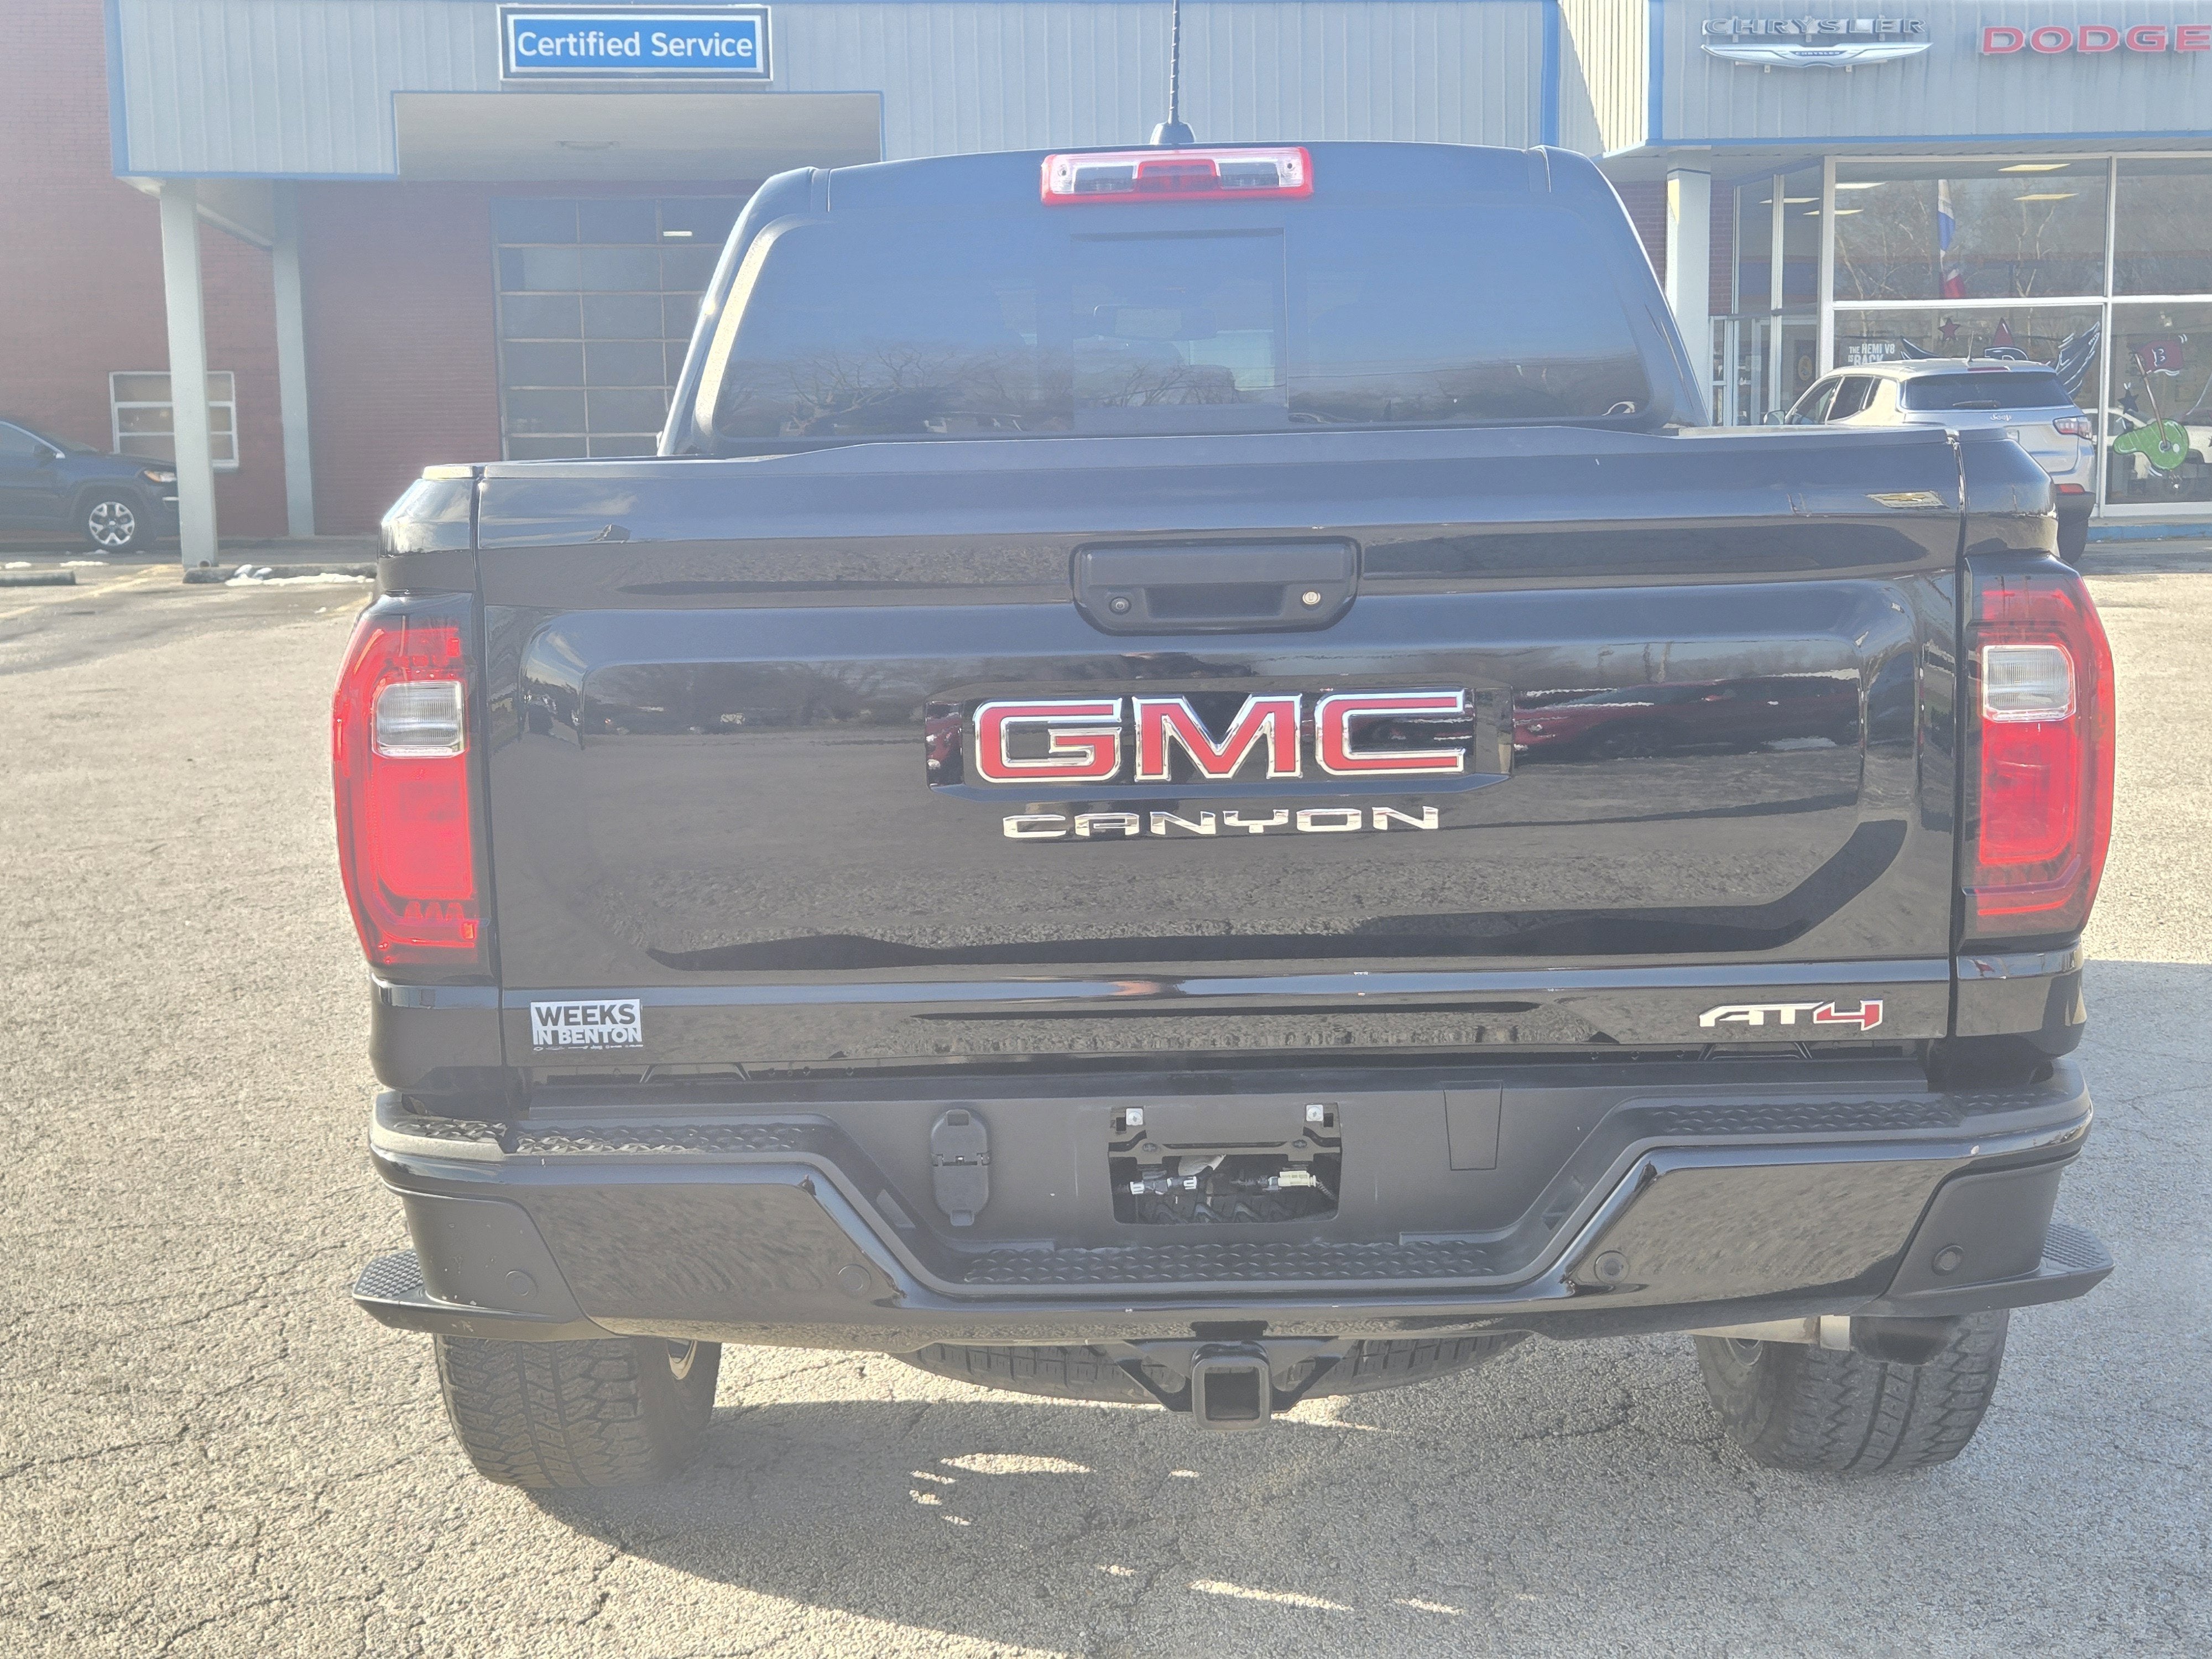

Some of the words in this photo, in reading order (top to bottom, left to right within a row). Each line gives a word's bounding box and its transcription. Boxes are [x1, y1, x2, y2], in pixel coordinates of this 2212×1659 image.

[1703, 18, 1926, 35] CHRYSLER
[1982, 25, 2212, 54] DODGE
[517, 31, 640, 56] Certified
[651, 32, 753, 57] Service
[1861, 343, 1882, 354] HEMI
[1885, 343, 1895, 354] V8
[973, 688, 1465, 784] GMC
[1003, 805, 1439, 839] CANYON
[535, 1003, 636, 1026] WEEKS
[1699, 999, 1884, 1031] AT4
[533, 1029, 552, 1045] IN
[558, 1027, 643, 1045] BENTON
